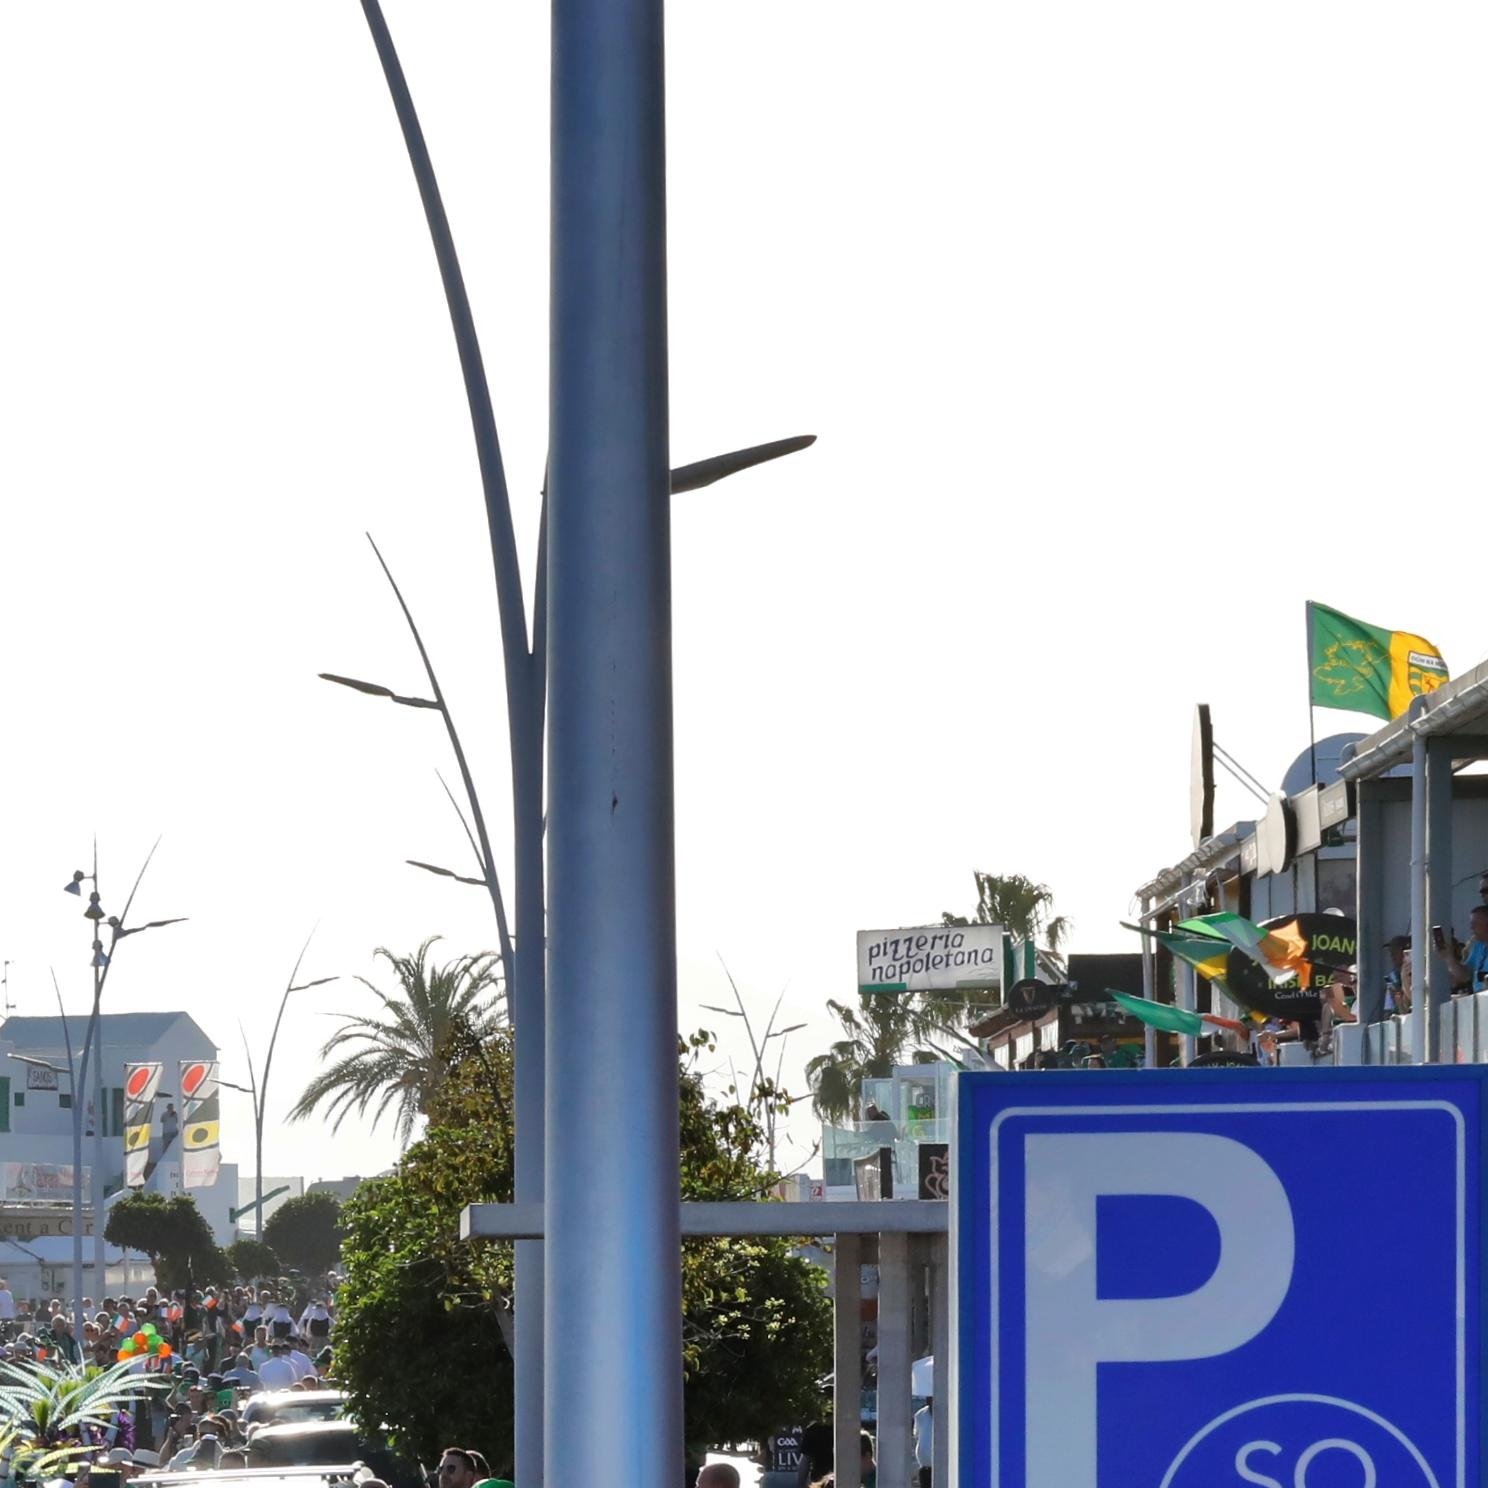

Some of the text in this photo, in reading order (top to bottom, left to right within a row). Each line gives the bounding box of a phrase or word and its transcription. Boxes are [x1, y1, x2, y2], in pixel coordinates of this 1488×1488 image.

[868, 930, 964, 966] pizzeria
[871, 947, 993, 982] napoletana
[40, 1223, 49, 1234] a
[58, 1219, 94, 1234] Cr
[778, 1453, 804, 1466] LIV
